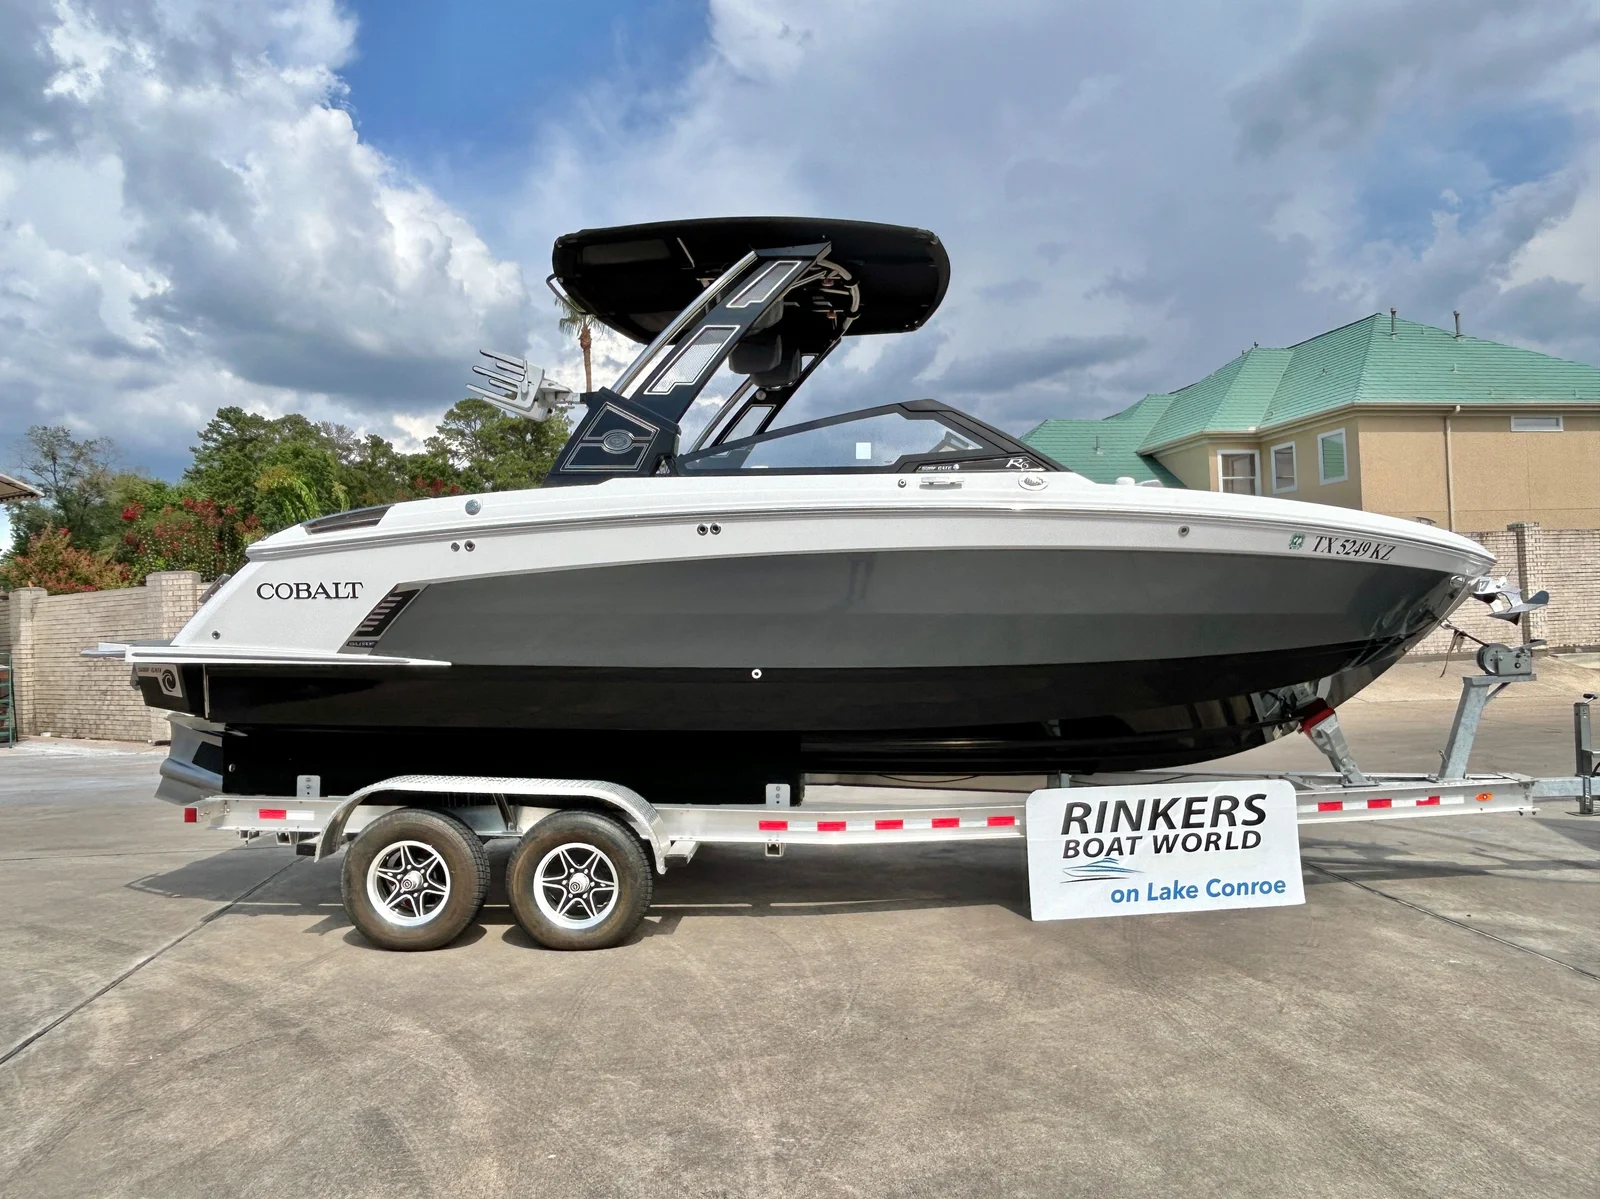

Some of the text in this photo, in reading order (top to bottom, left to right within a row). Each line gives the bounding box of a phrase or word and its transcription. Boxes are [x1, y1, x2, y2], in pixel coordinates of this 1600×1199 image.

[1312, 535, 1338, 554] TX
[1336, 539, 1372, 557] 5249
[1369, 543, 1396, 561] KZ
[256, 581, 364, 600] COBALT
[1060, 793, 1267, 835] RINKERS
[1062, 830, 1262, 859] BOAT WORLD
[1110, 878, 1287, 904] on Lake Conroe
